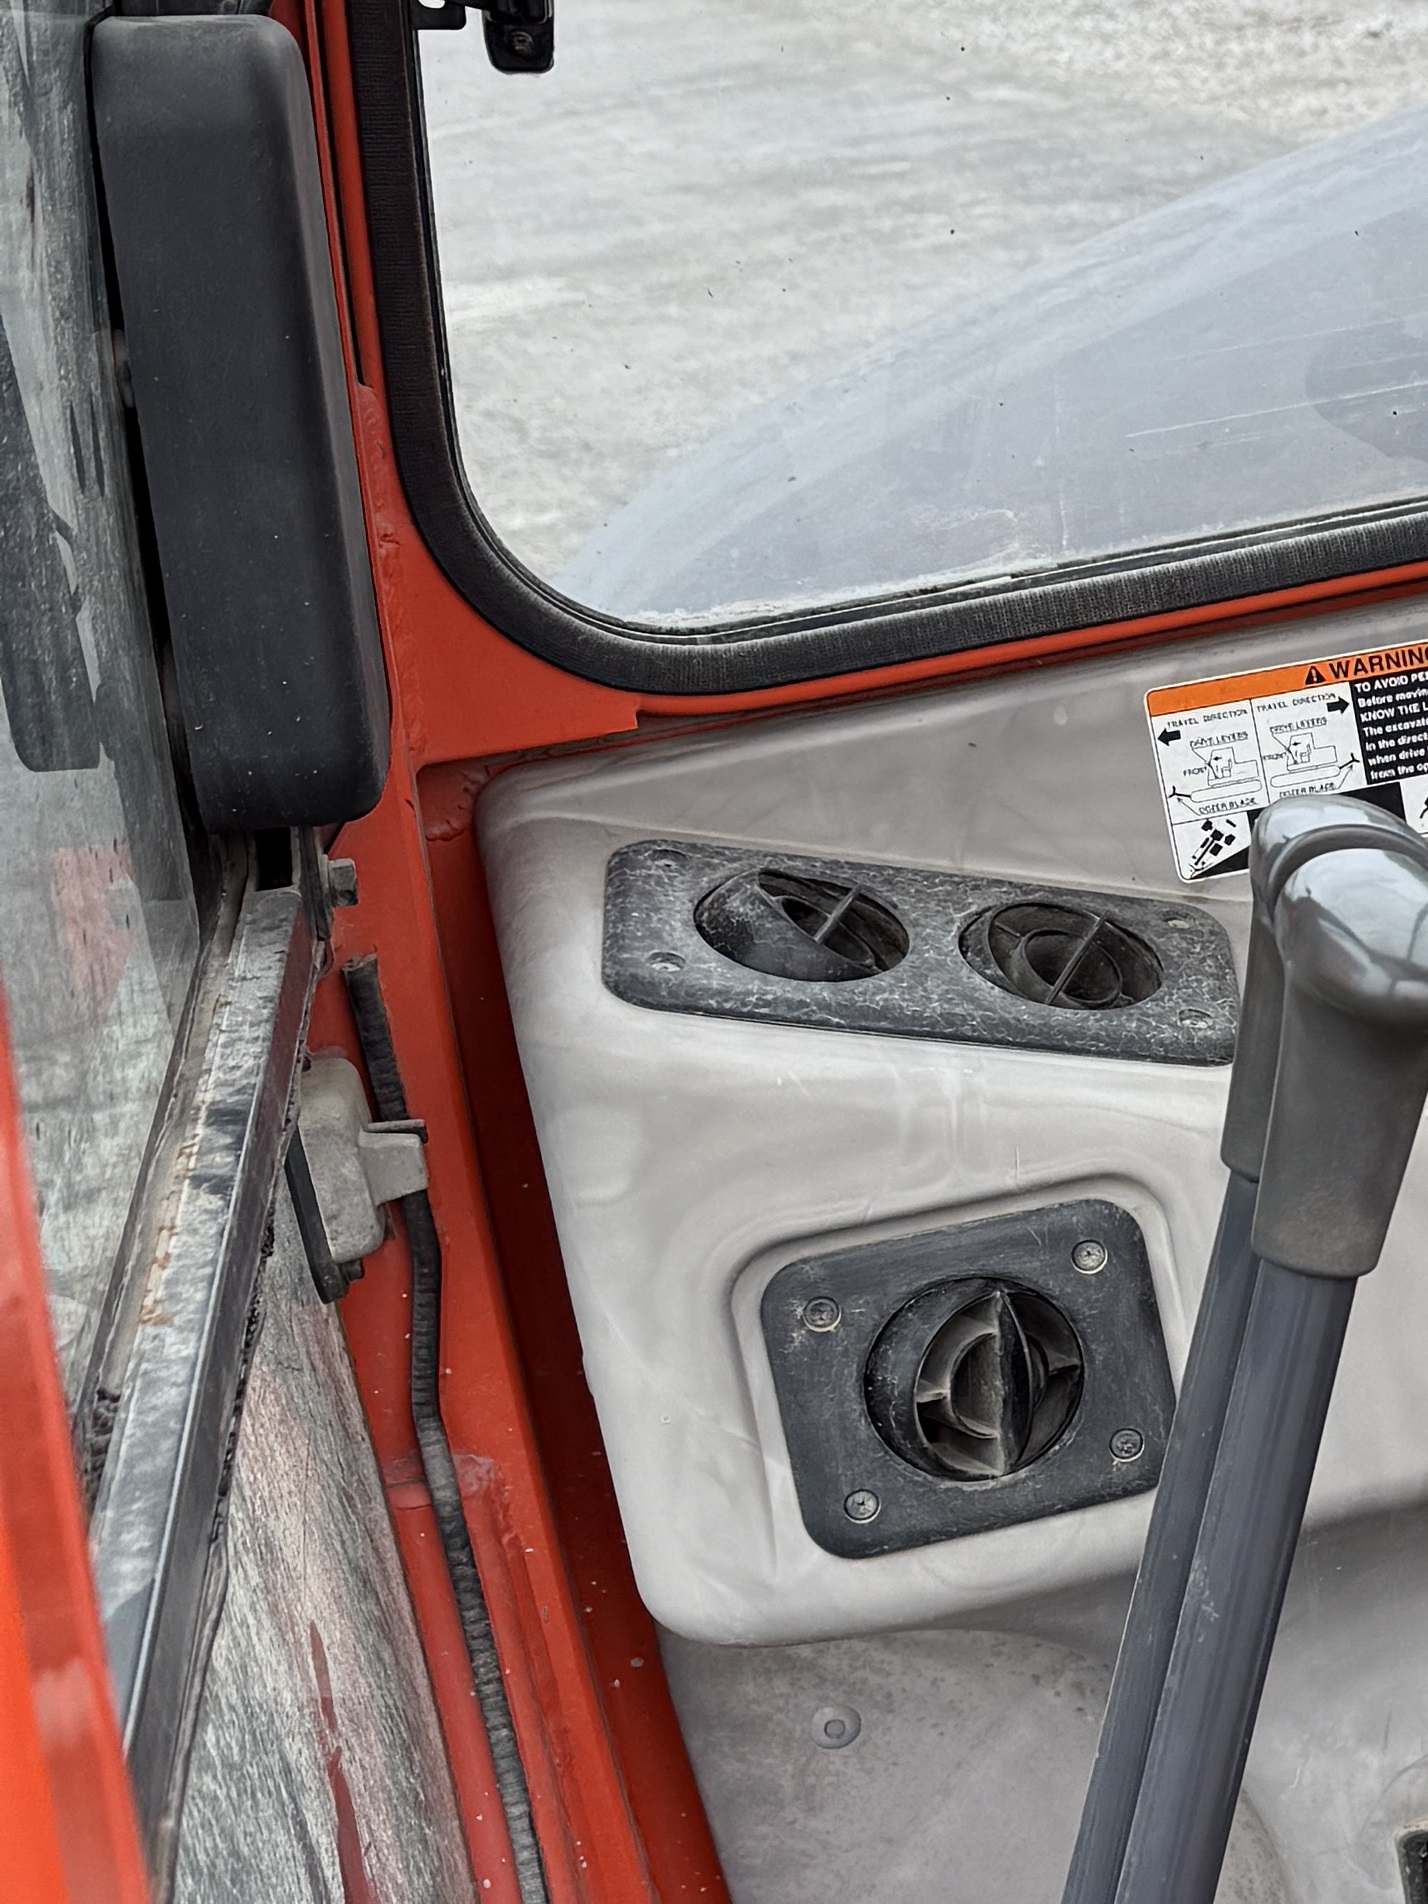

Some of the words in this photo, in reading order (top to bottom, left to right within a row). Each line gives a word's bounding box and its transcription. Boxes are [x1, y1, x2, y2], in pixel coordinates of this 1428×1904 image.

[1354, 681, 1370, 692] TO
[1373, 675, 1408, 689] AVOID
[1357, 694, 1393, 707] Before
[1359, 707, 1394, 722] KNOW
[1396, 702, 1420, 715] THE
[1362, 726, 1383, 736] The
[1377, 739, 1395, 749] the
[1368, 753, 1396, 766] when
[1398, 748, 1425, 759] drive
[1370, 768, 1395, 779] from
[1397, 765, 1414, 775] the
